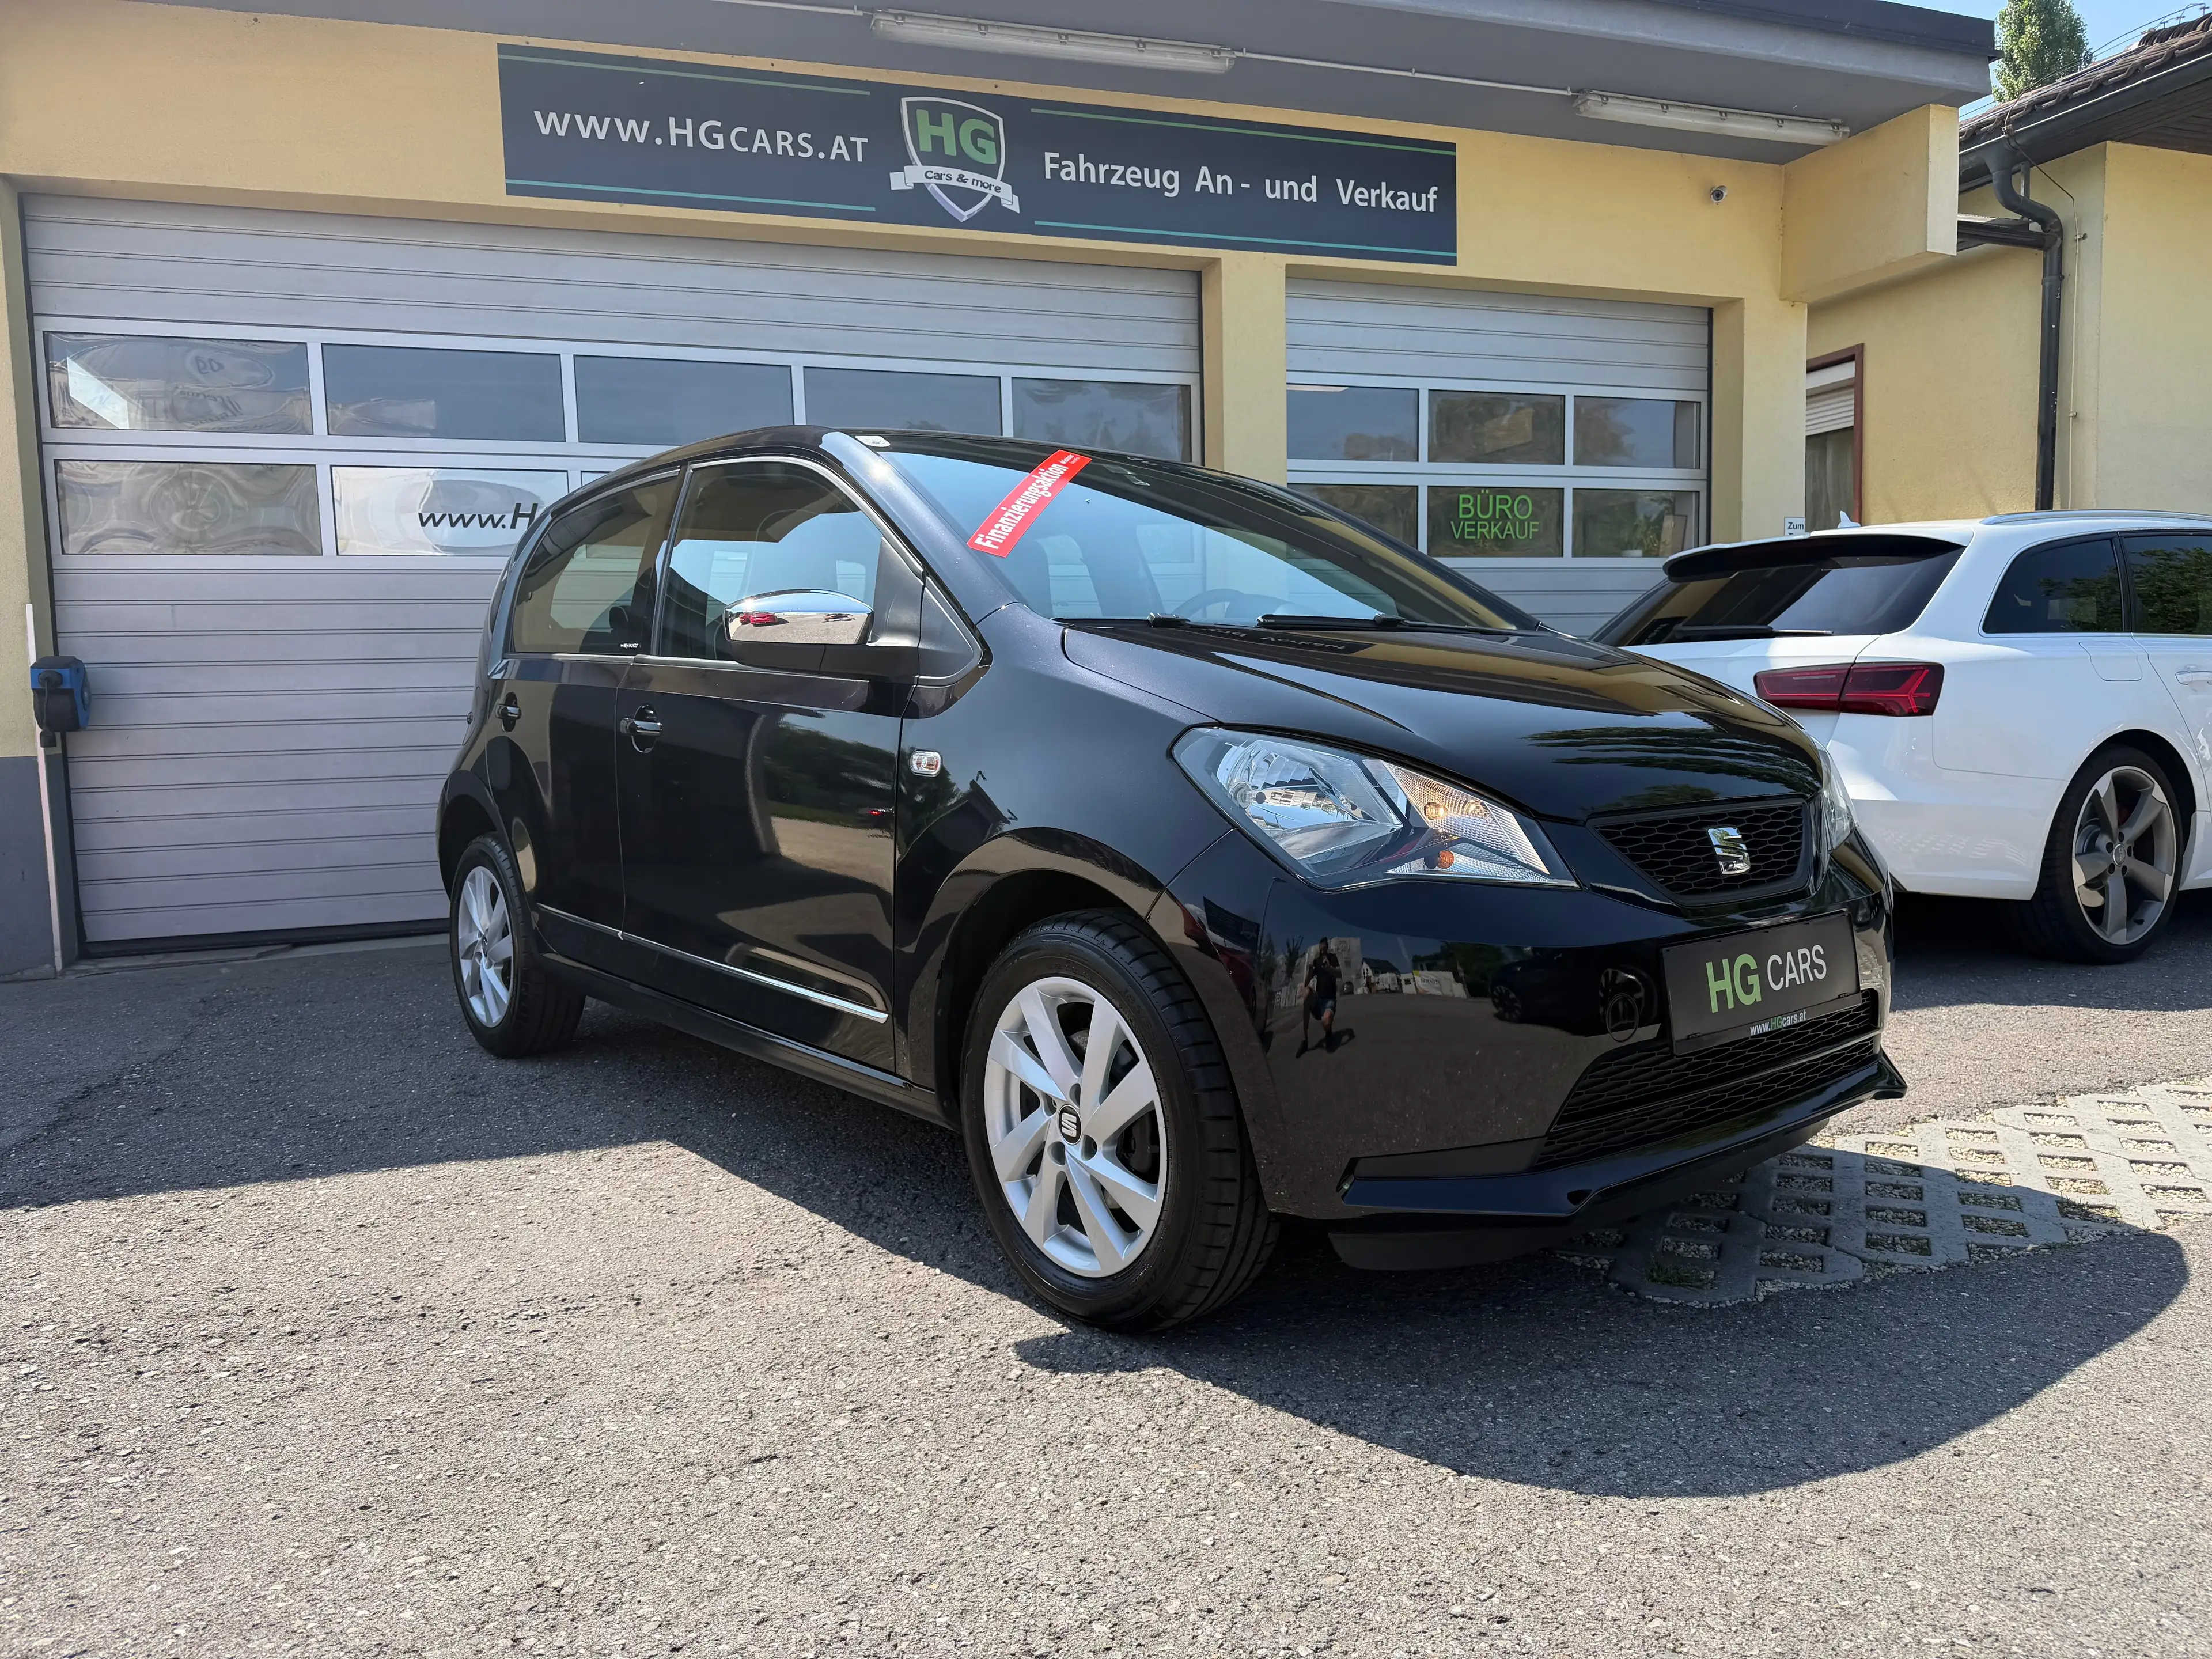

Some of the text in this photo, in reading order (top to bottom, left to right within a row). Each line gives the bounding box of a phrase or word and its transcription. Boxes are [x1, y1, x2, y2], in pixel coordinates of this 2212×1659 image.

[916, 109, 997, 164] HG
[924, 170, 1001, 193] Cars & more
[1044, 151, 1180, 198] Fahrzeug
[1265, 175, 1317, 202] und
[1336, 179, 1438, 213] Verkauf
[974, 462, 1069, 550] Finanzierungsaktion
[1459, 489, 1532, 520] BÜRO
[1450, 521, 1540, 539] VERKAUF
[1787, 521, 1804, 530] Zum
[1706, 944, 1827, 1013] HG CARS
[1749, 1009, 1807, 1036] www.HGcars.at
